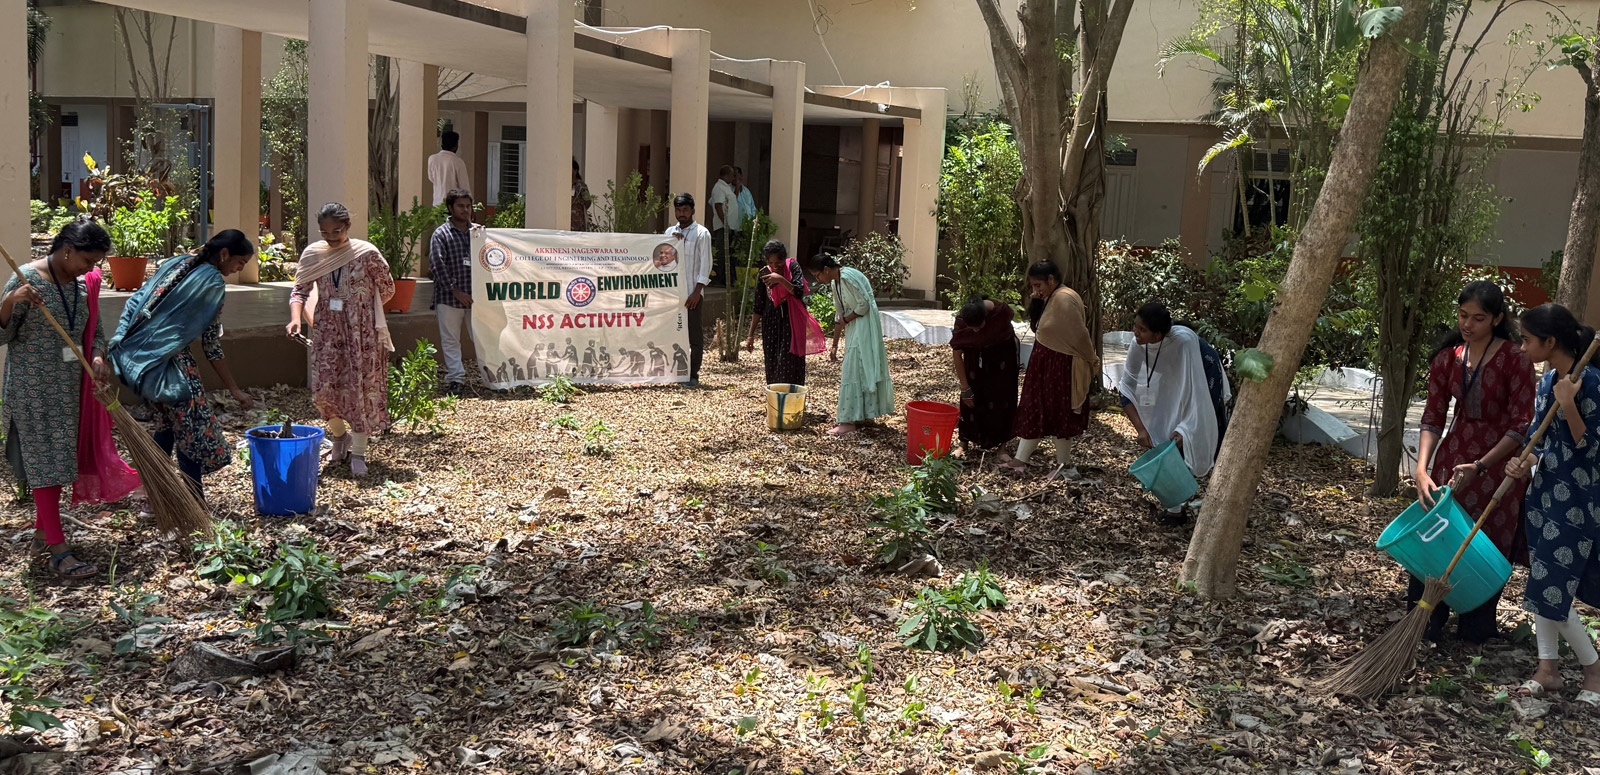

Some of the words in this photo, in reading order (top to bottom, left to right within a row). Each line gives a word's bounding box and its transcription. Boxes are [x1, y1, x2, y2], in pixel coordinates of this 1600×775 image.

[486, 281, 560, 301] WORLD
[597, 273, 678, 291] ENVIRONMENT
[625, 294, 648, 308] DAY
[522, 314, 554, 330] NSS
[560, 312, 645, 328] ACTIVITY
